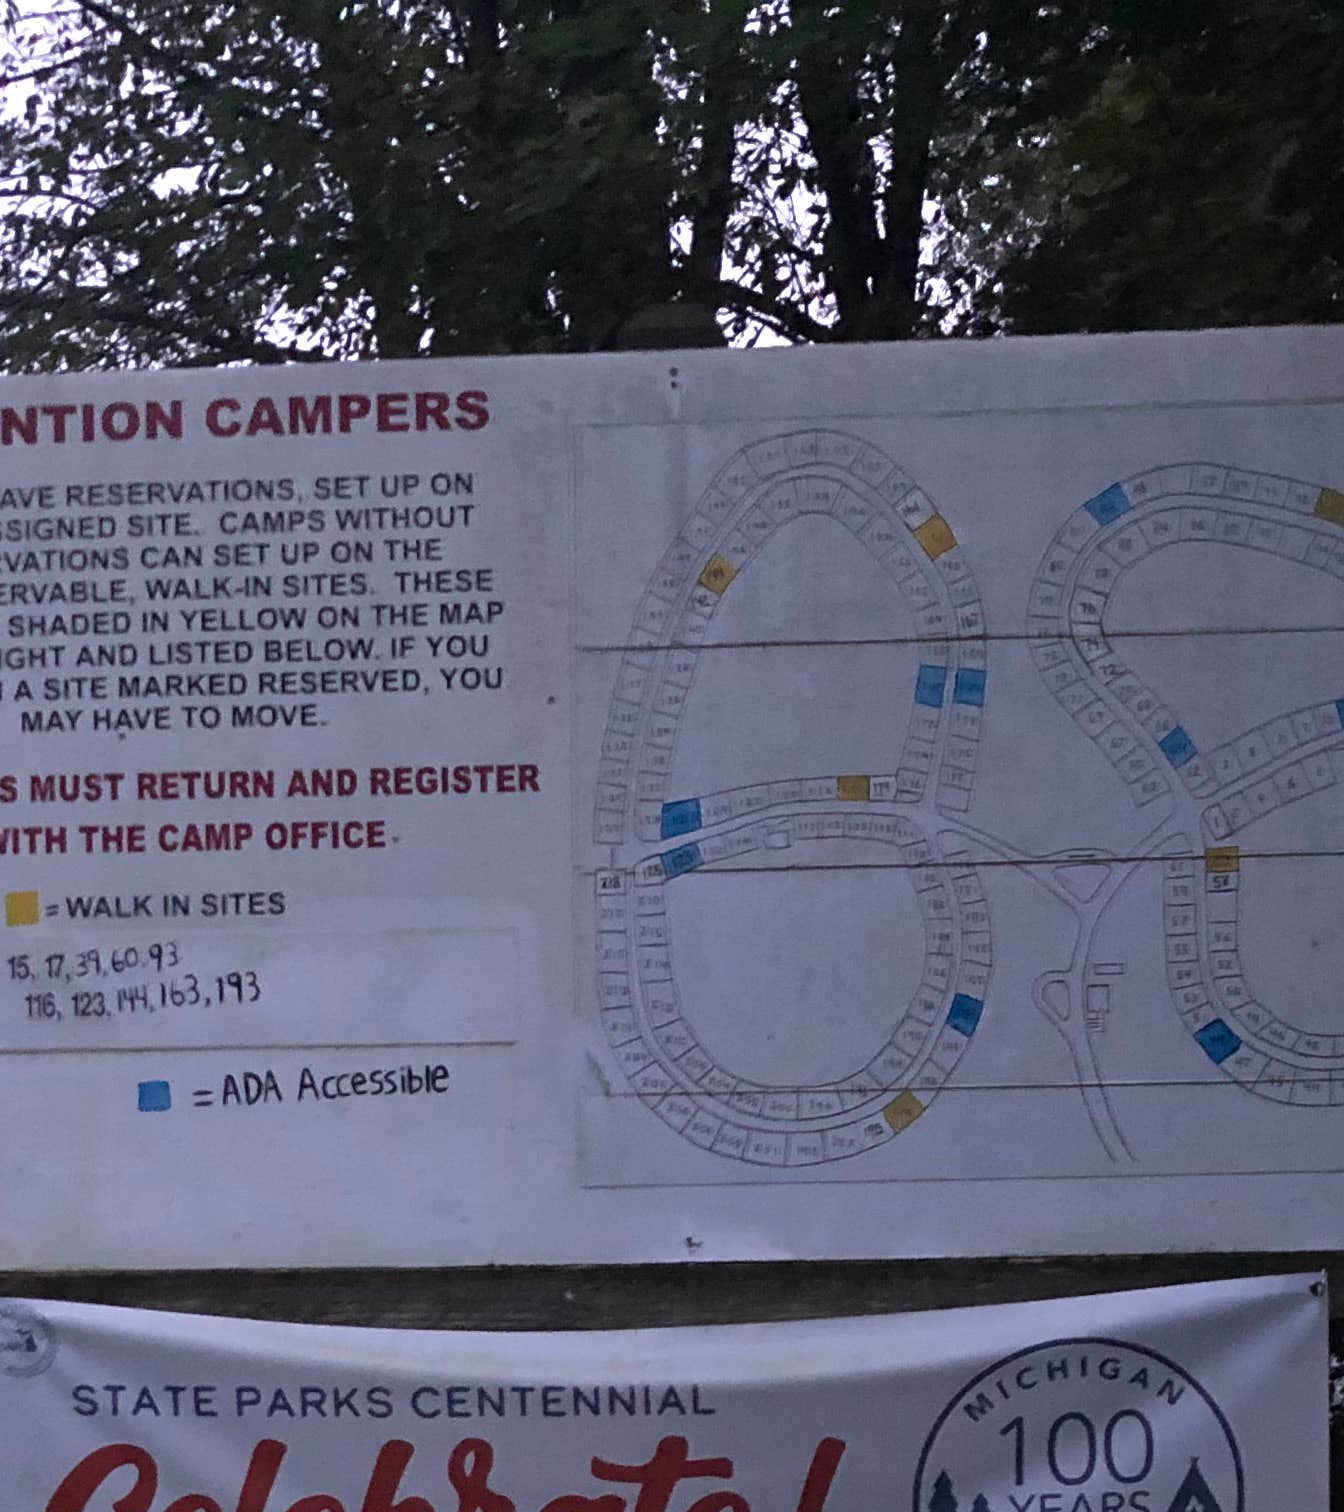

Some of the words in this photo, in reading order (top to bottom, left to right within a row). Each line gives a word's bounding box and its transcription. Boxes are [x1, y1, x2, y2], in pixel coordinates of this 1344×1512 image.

[202, 390, 492, 439] CAMPERS
[62, 478, 307, 511] RESERVATIONS,
[310, 475, 369, 501] SET
[378, 474, 420, 498] UP
[429, 472, 474, 497] ON
[123, 512, 203, 538] SITE.
[214, 509, 323, 535] CAMPS
[331, 504, 476, 532] WITHOUT
[140, 545, 204, 569] CAN
[213, 542, 272, 567] SET
[281, 541, 321, 566] UP
[330, 540, 374, 564] ON
[383, 538, 444, 562] THE
[144, 575, 273, 601] WALK-IN
[282, 572, 378, 598] SITES.
[393, 568, 494, 594] THESE
[8, 611, 132, 638] SHADED
[141, 611, 170, 633] IN
[180, 607, 308, 633] YELLOW
[317, 606, 361, 630] ON
[370, 603, 429, 627] THE
[439, 600, 505, 625] MAP
[75, 643, 139, 667] AND
[149, 640, 254, 666] LISTED
[264, 637, 381, 663] BELOW.
[391, 635, 416, 660] IF
[426, 634, 490, 658] YOU
[10, 679, 31, 702] A
[39, 676, 104, 701] SITE
[113, 672, 244, 698] MARKED
[253, 668, 432, 699] RESERVED,
[437, 666, 504, 691] YOU
[20, 709, 82, 733] MAY
[91, 706, 170, 732] HAVE
[179, 705, 220, 729] TO
[229, 703, 329, 729] MOVE.
[30, 773, 126, 803] MUST
[137, 770, 276, 801] RETURN
[287, 768, 359, 798] AND
[369, 764, 541, 796] REGISTER
[76, 824, 144, 853] THE
[155, 822, 252, 853] CAMP
[66, 895, 157, 919] WALK
[166, 894, 195, 917] IN
[204, 891, 287, 917] SITES
[216, 970, 261, 1005] 193
[222, 1069, 283, 1106] ADA
[297, 1063, 450, 1102] Accessible
[71, 1384, 219, 1417] STATE
[235, 1385, 395, 1419] PARKS
[410, 1385, 717, 1419] CENTENNIAL
[962, 1355, 1187, 1423] MICHIGAN
[998, 1407, 1155, 1487] 100
